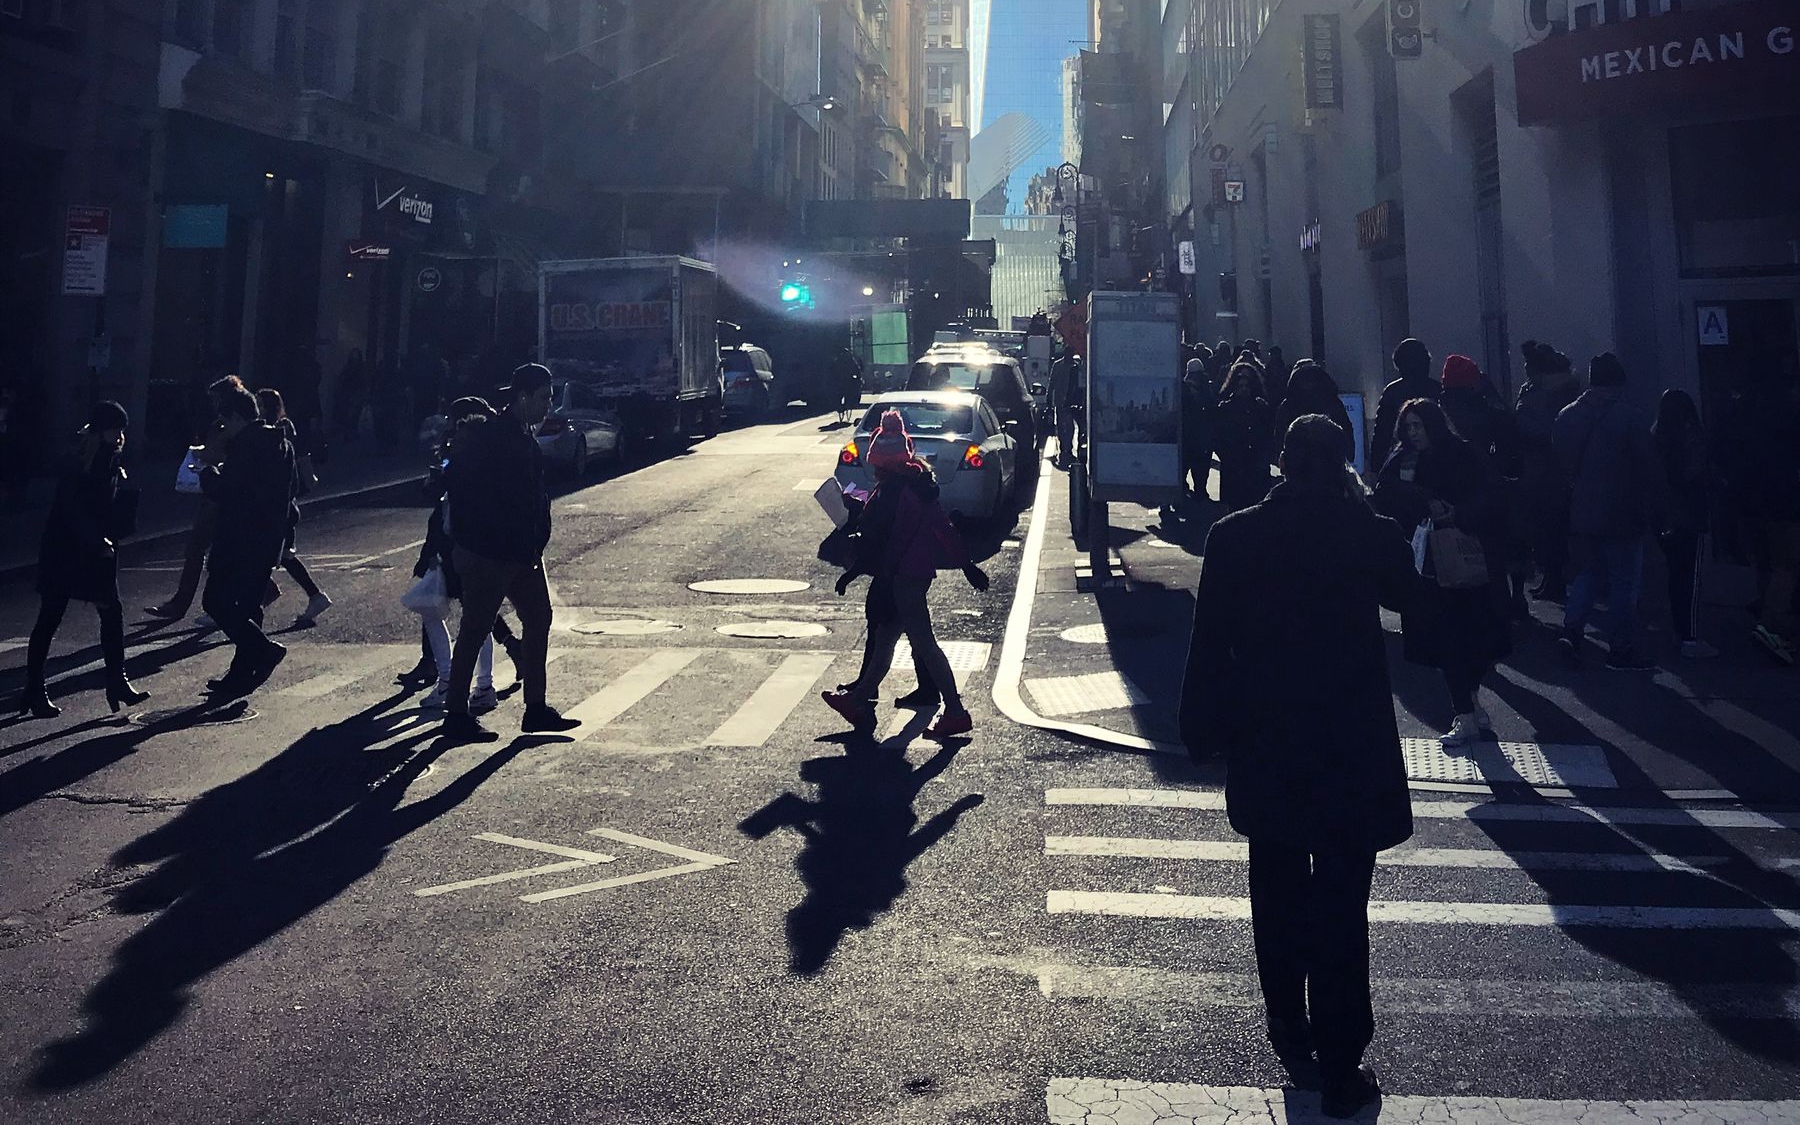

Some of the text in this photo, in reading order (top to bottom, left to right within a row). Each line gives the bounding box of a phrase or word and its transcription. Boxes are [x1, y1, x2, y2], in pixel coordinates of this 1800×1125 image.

[1581, 31, 1744, 83] MEXICAN
[400, 193, 432, 224] verizon
[366, 247, 390, 255] verizon
[1703, 311, 1724, 335] A
